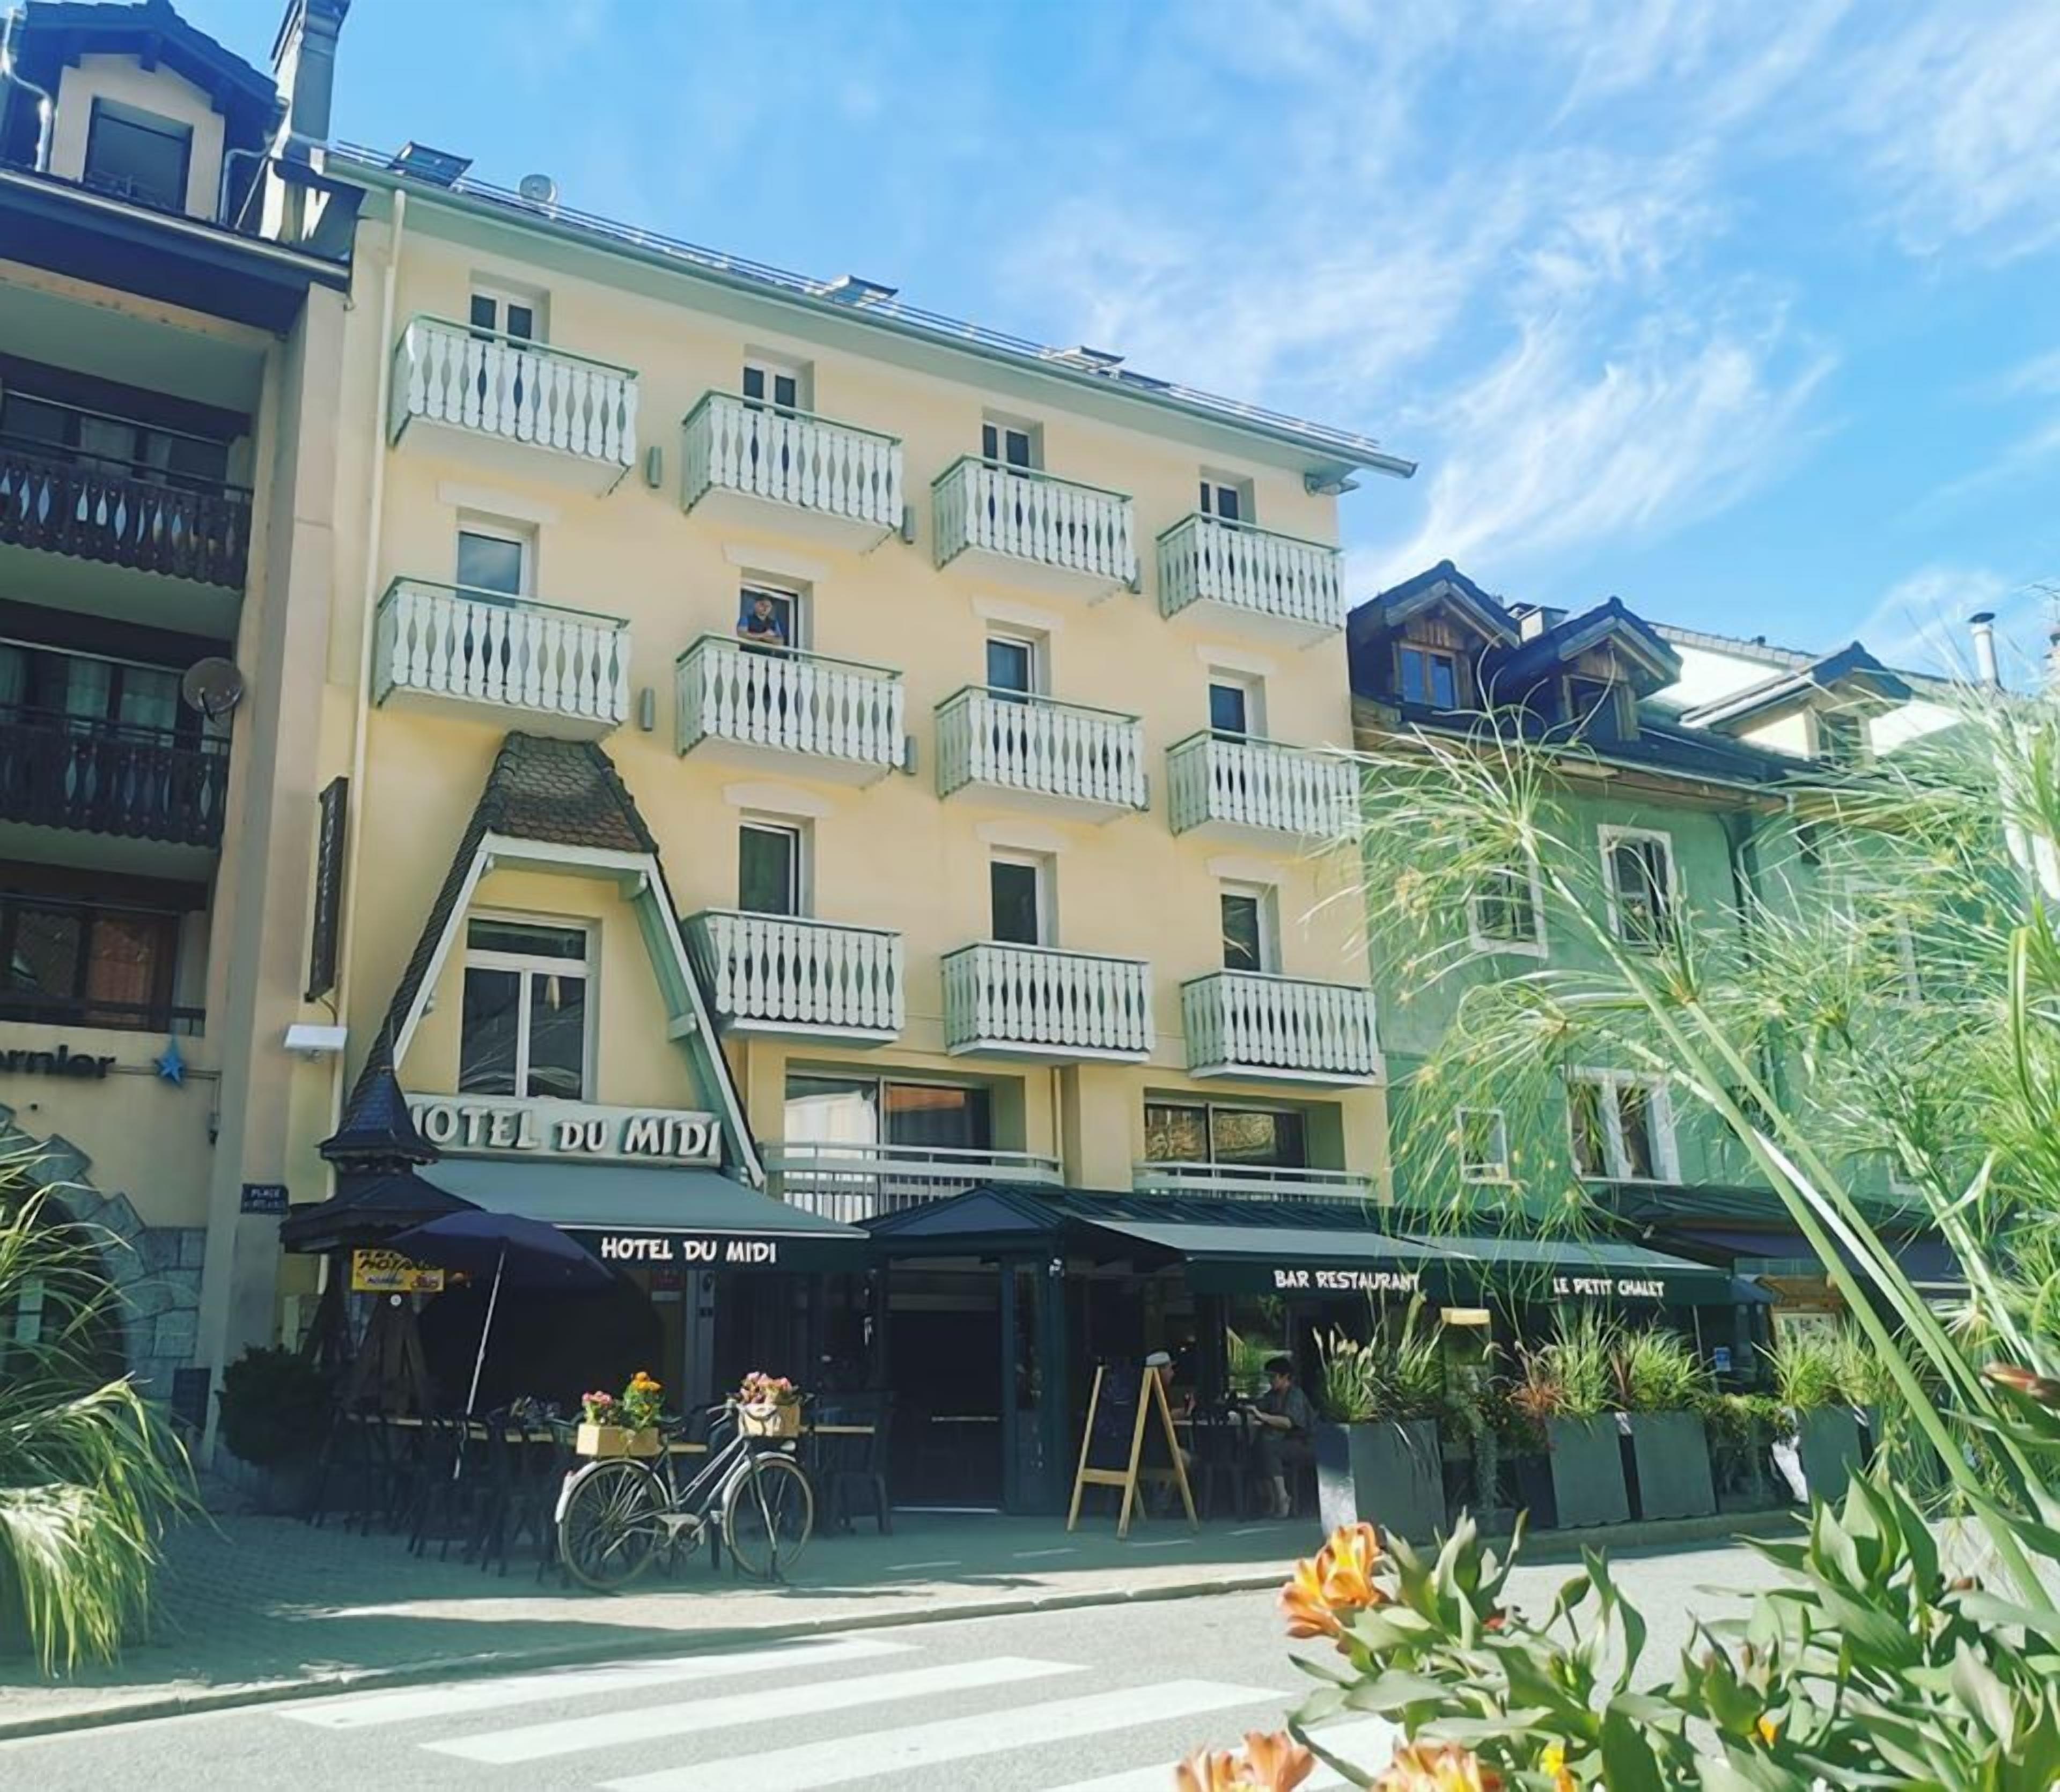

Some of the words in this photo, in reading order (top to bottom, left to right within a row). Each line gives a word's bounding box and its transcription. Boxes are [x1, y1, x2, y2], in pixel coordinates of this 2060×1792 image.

[560, 1119, 607, 1152] DU
[623, 1116, 720, 1157] MIDI
[601, 1237, 673, 1260] HOTEL
[683, 1240, 717, 1261] DU
[726, 1241, 777, 1264] MIDI
[1274, 1270, 1309, 1288] BAR
[1315, 1270, 1419, 1291] RESTAURANT
[1554, 1277, 1570, 1294] LE
[1573, 1278, 1613, 1295] PETIT
[1618, 1279, 1664, 1298] CHALET
